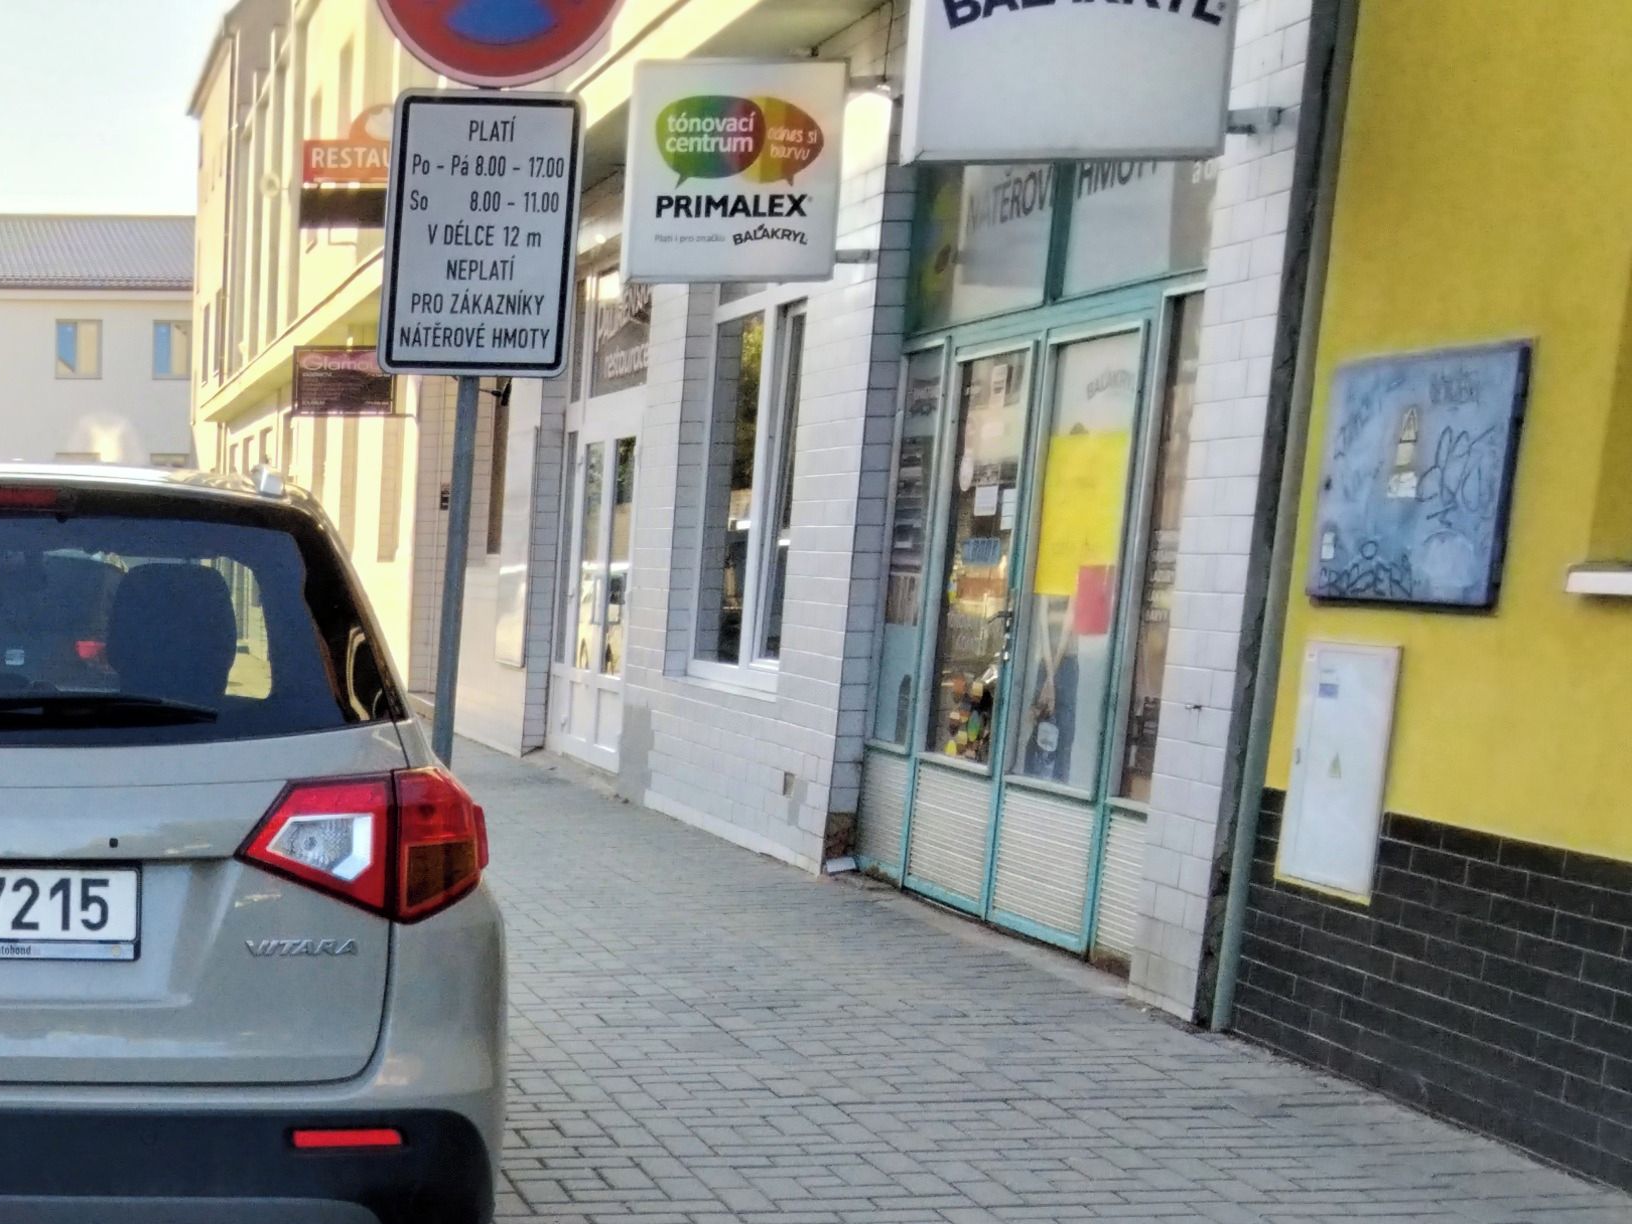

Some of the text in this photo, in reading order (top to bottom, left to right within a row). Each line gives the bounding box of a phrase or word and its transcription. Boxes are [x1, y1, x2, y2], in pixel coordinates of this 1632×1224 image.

[468, 116, 516, 143] PLATÍ
[668, 112, 756, 134] tónovací
[665, 134, 754, 153] centrum
[770, 144, 811, 161] barvu
[412, 154, 430, 176] Po
[451, 154, 469, 177] Pá
[475, 155, 506, 177] 8.00
[528, 156, 564, 179] 17.00
[410, 189, 428, 212] So
[470, 190, 501, 213] 8.00
[524, 191, 559, 214] 11.00
[655, 194, 808, 219] PRIMALEX
[428, 219, 541, 248] V DÉLCE 12 m
[446, 255, 516, 281] NEPLATÍ
[411, 289, 544, 316] PRO ZÁKAZNÍKY
[399, 322, 550, 349] NÁTĚROVÉ HMOTY
